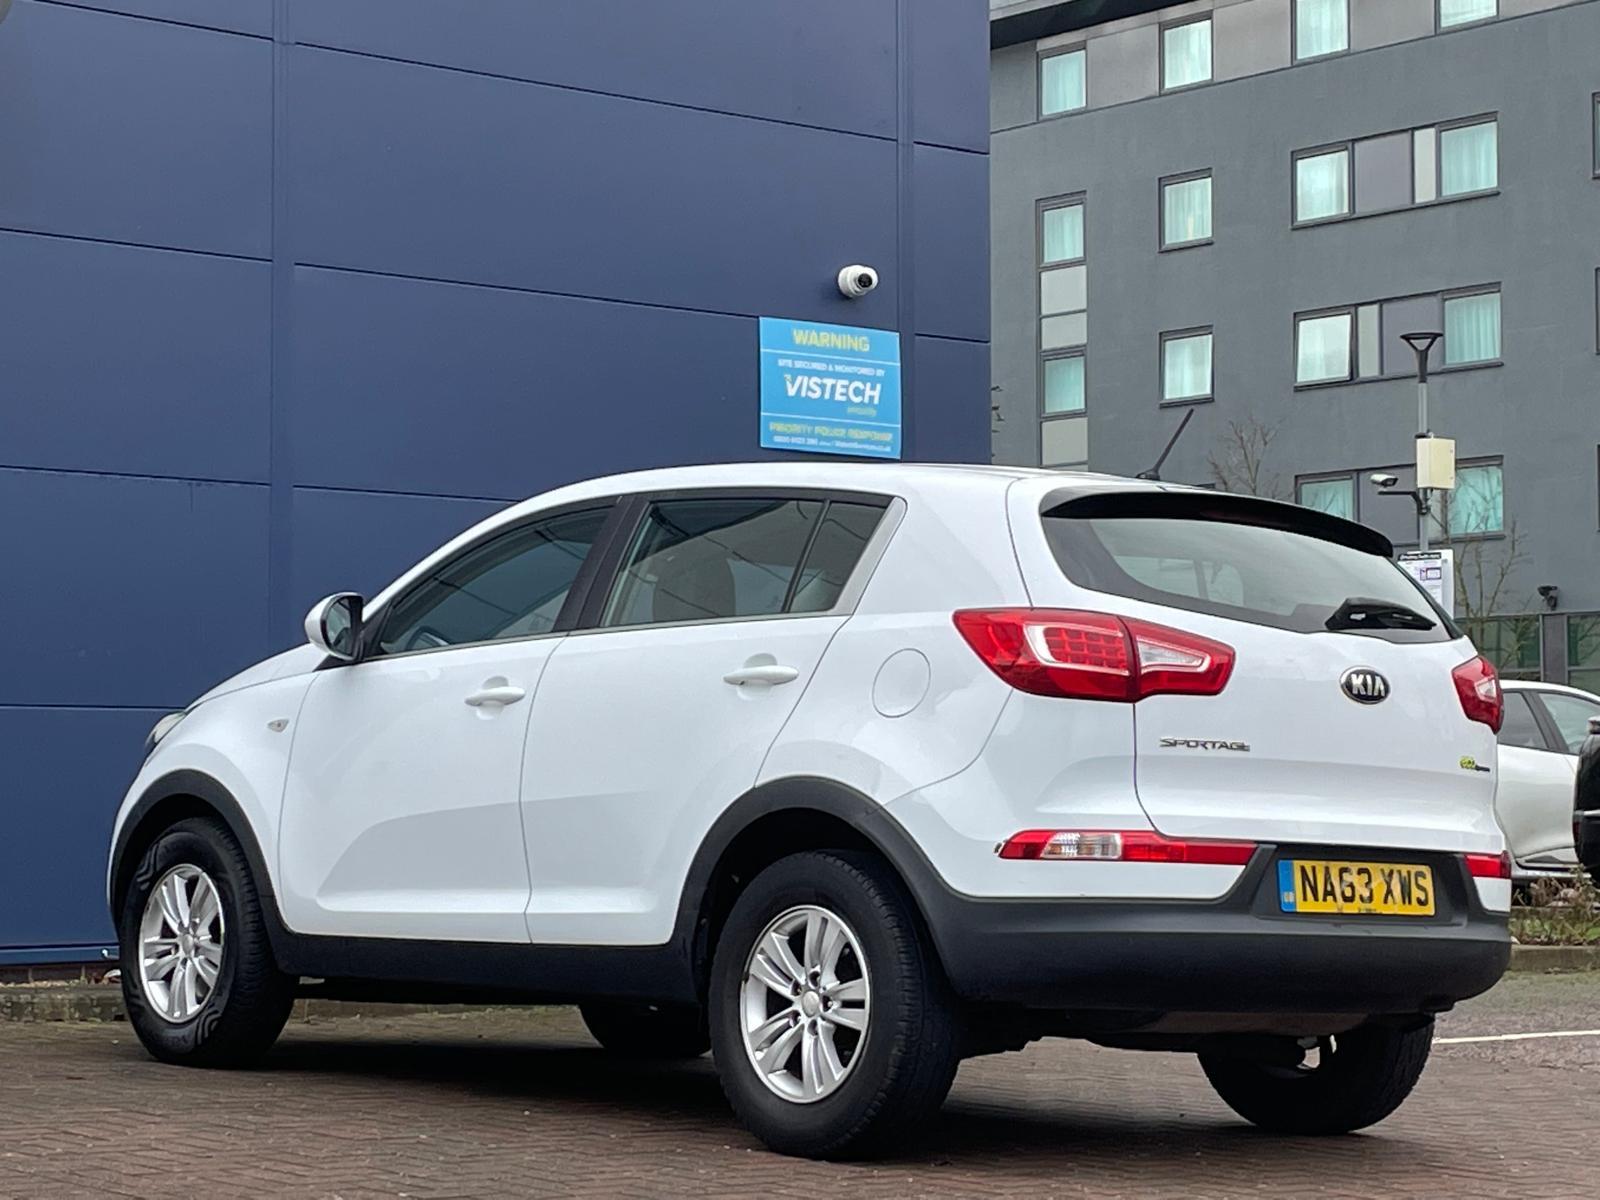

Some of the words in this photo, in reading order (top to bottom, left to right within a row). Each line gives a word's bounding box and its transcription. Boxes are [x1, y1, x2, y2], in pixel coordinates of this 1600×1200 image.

[793, 328, 870, 352] WARNING
[784, 374, 882, 405] VISTECH
[1351, 673, 1386, 697] KIA
[1159, 738, 1251, 752] SPORTAGE
[1299, 865, 1375, 904] NA63
[1380, 868, 1430, 907] XWS
